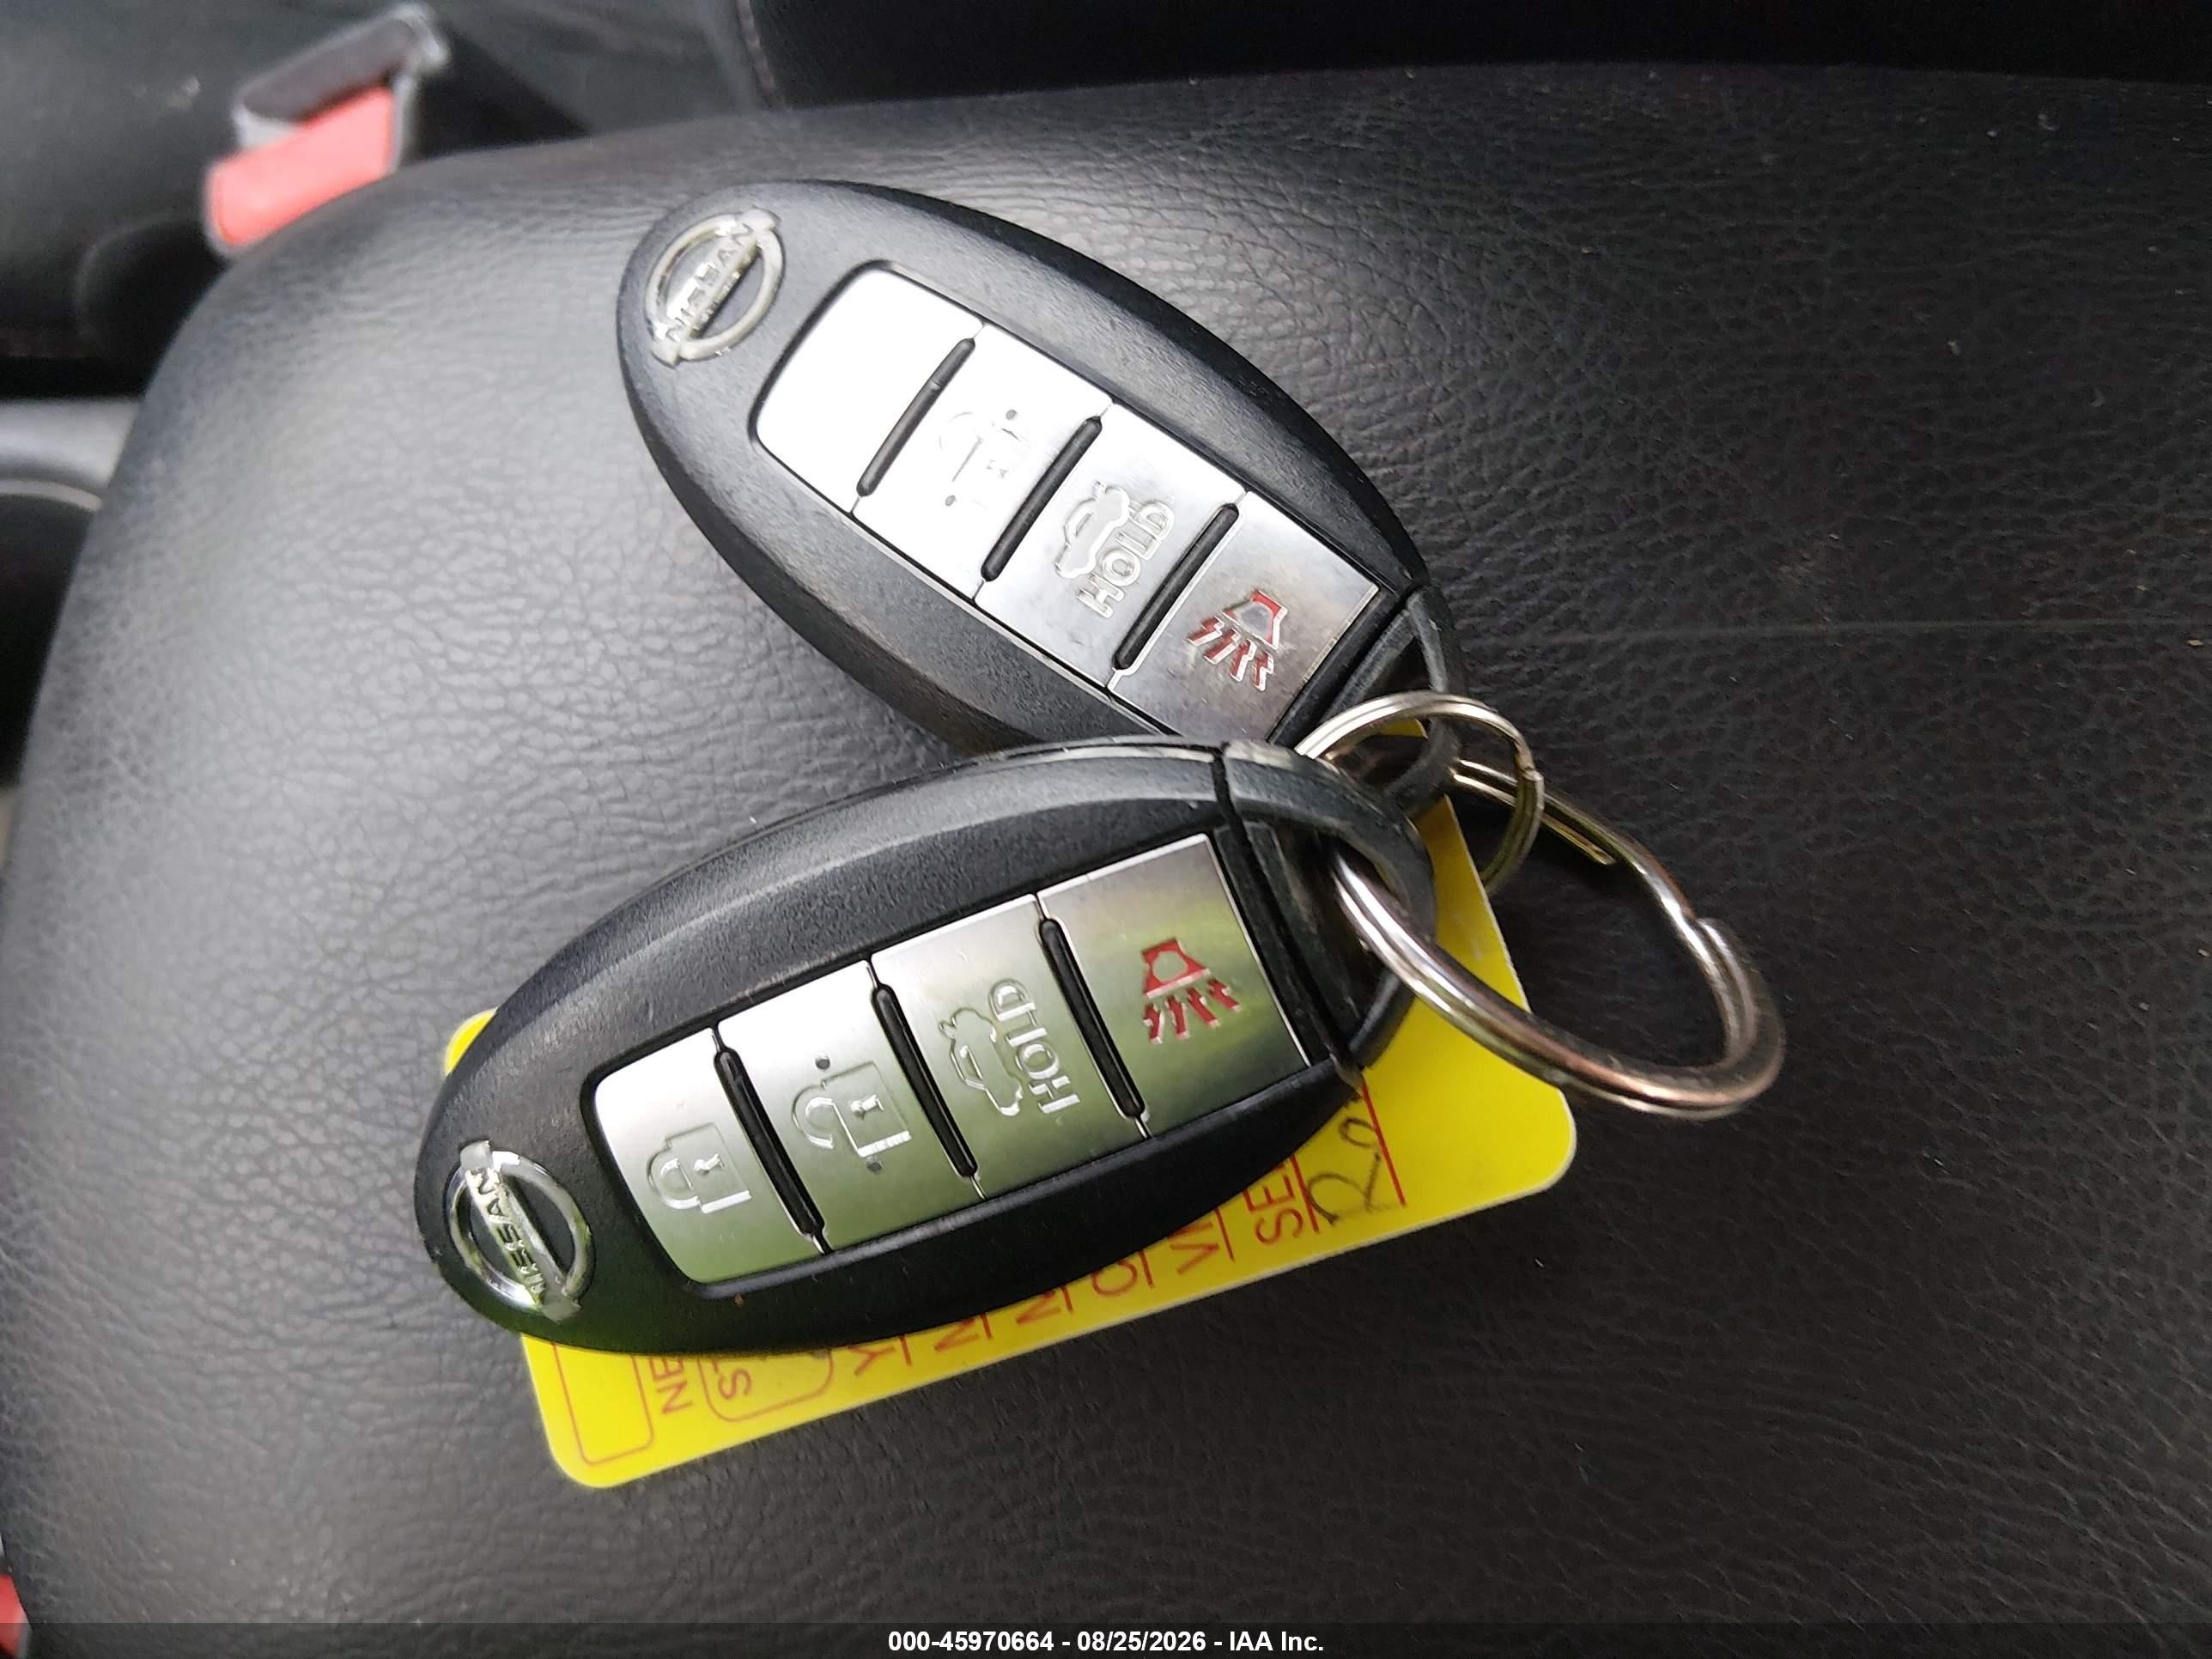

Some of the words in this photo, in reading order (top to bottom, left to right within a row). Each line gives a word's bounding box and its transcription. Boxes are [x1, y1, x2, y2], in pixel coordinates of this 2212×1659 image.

[1077, 498, 1175, 618] HOLD
[988, 978, 1081, 1114] HOLD
[470, 1165, 548, 1304] NISSAN
